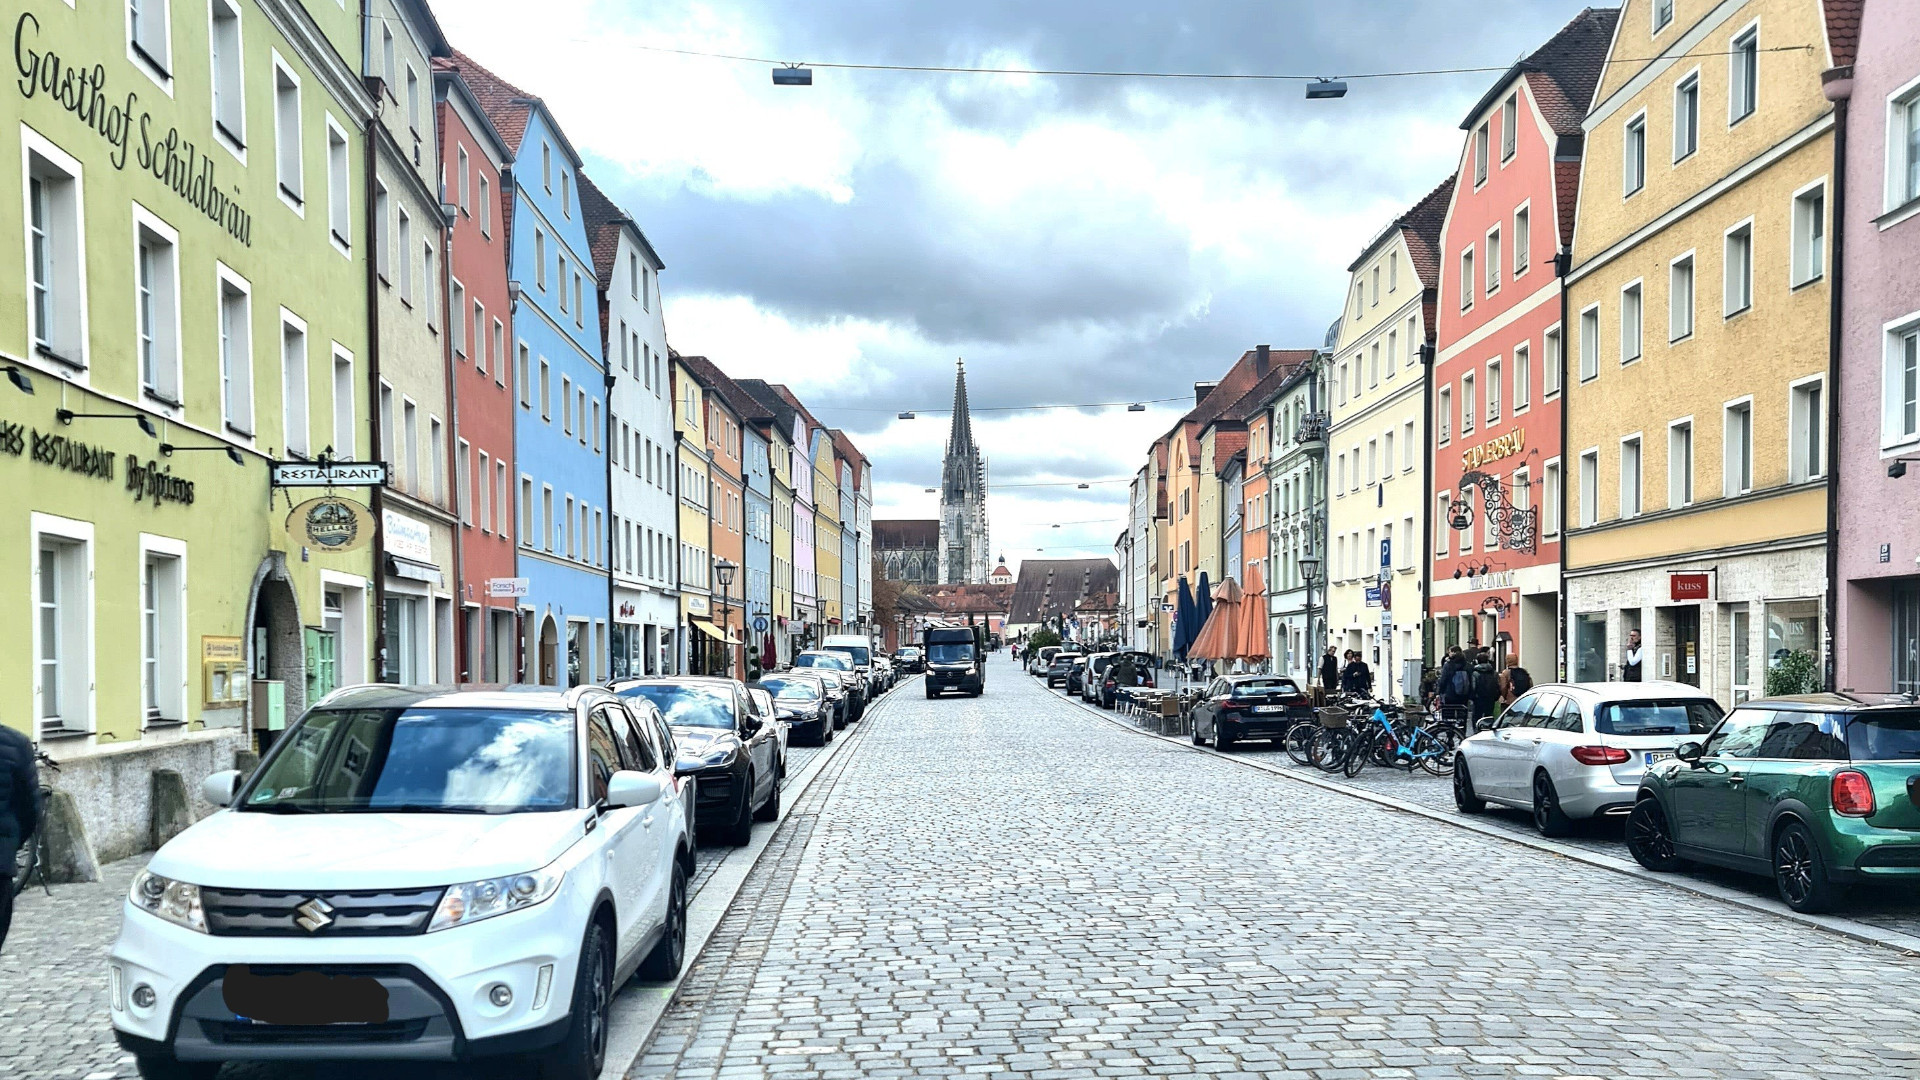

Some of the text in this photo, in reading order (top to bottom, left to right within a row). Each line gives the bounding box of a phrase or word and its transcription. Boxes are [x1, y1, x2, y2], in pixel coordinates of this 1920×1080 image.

[14, 12, 252, 248] Gasthof Schildbräu
[31, 427, 115, 482] RESTAURANT
[1462, 425, 1526, 472] STADLERBRÄU
[281, 469, 380, 479] RESTAURANT
[313, 524, 351, 533] HELLAS
[1382, 542, 1389, 563] P
[1677, 580, 1702, 591] kuss
